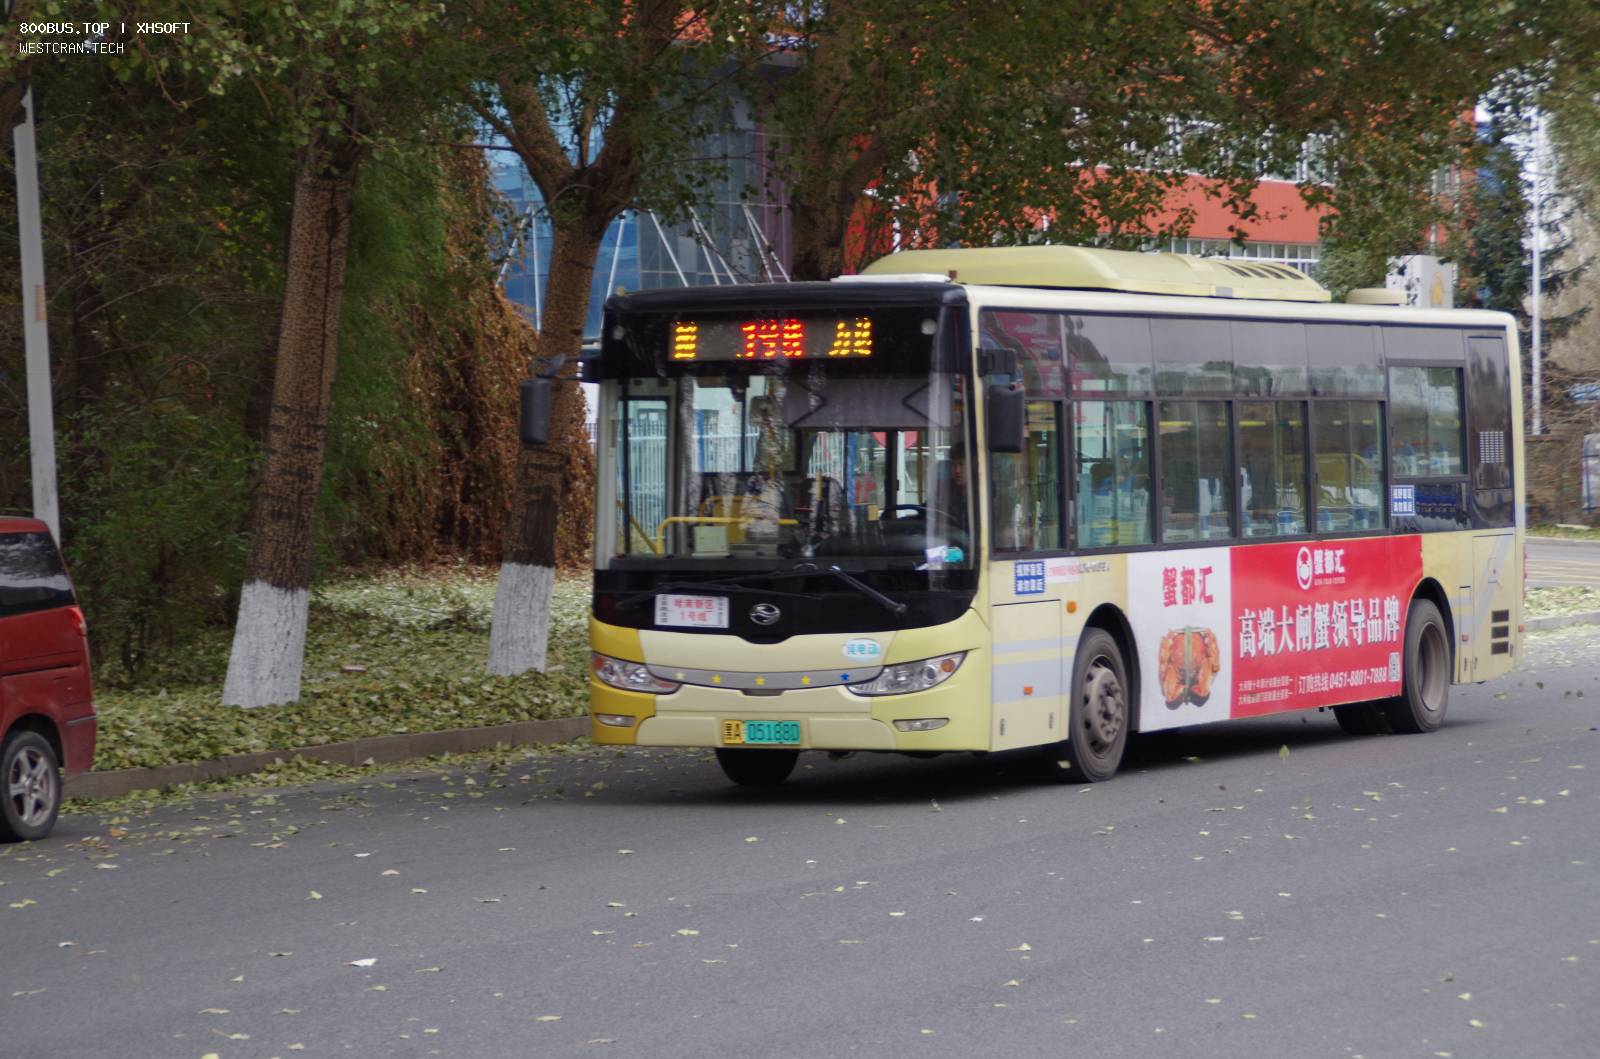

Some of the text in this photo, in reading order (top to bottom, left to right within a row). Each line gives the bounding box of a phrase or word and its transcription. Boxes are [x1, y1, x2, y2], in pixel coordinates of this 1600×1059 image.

[1162, 566, 1214, 607] 蟹都汇
[1238, 595, 1400, 659] 高端大闸蟹领导品牌
